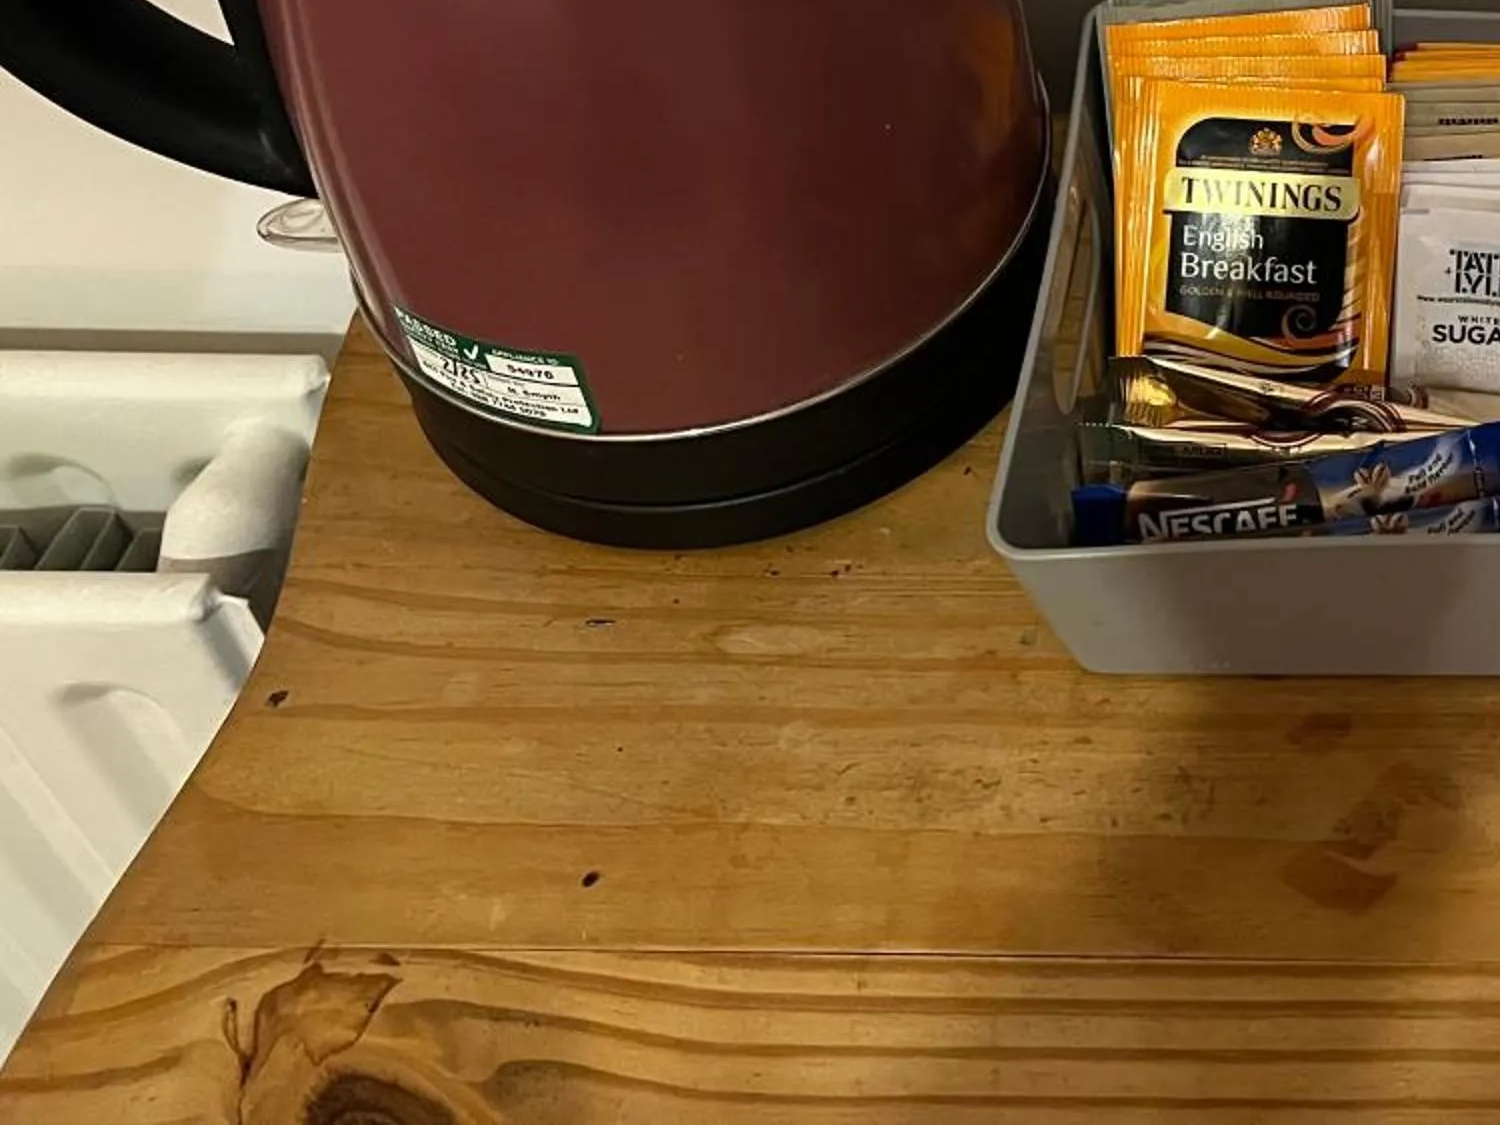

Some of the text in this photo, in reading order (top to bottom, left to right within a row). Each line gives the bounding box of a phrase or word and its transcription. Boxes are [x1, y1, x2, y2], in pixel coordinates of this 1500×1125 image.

[1181, 176, 1342, 212] TWININGS
[1182, 222, 1264, 252] English
[1180, 252, 1318, 286] Breakfast
[1458, 314, 1500, 325] WHITE
